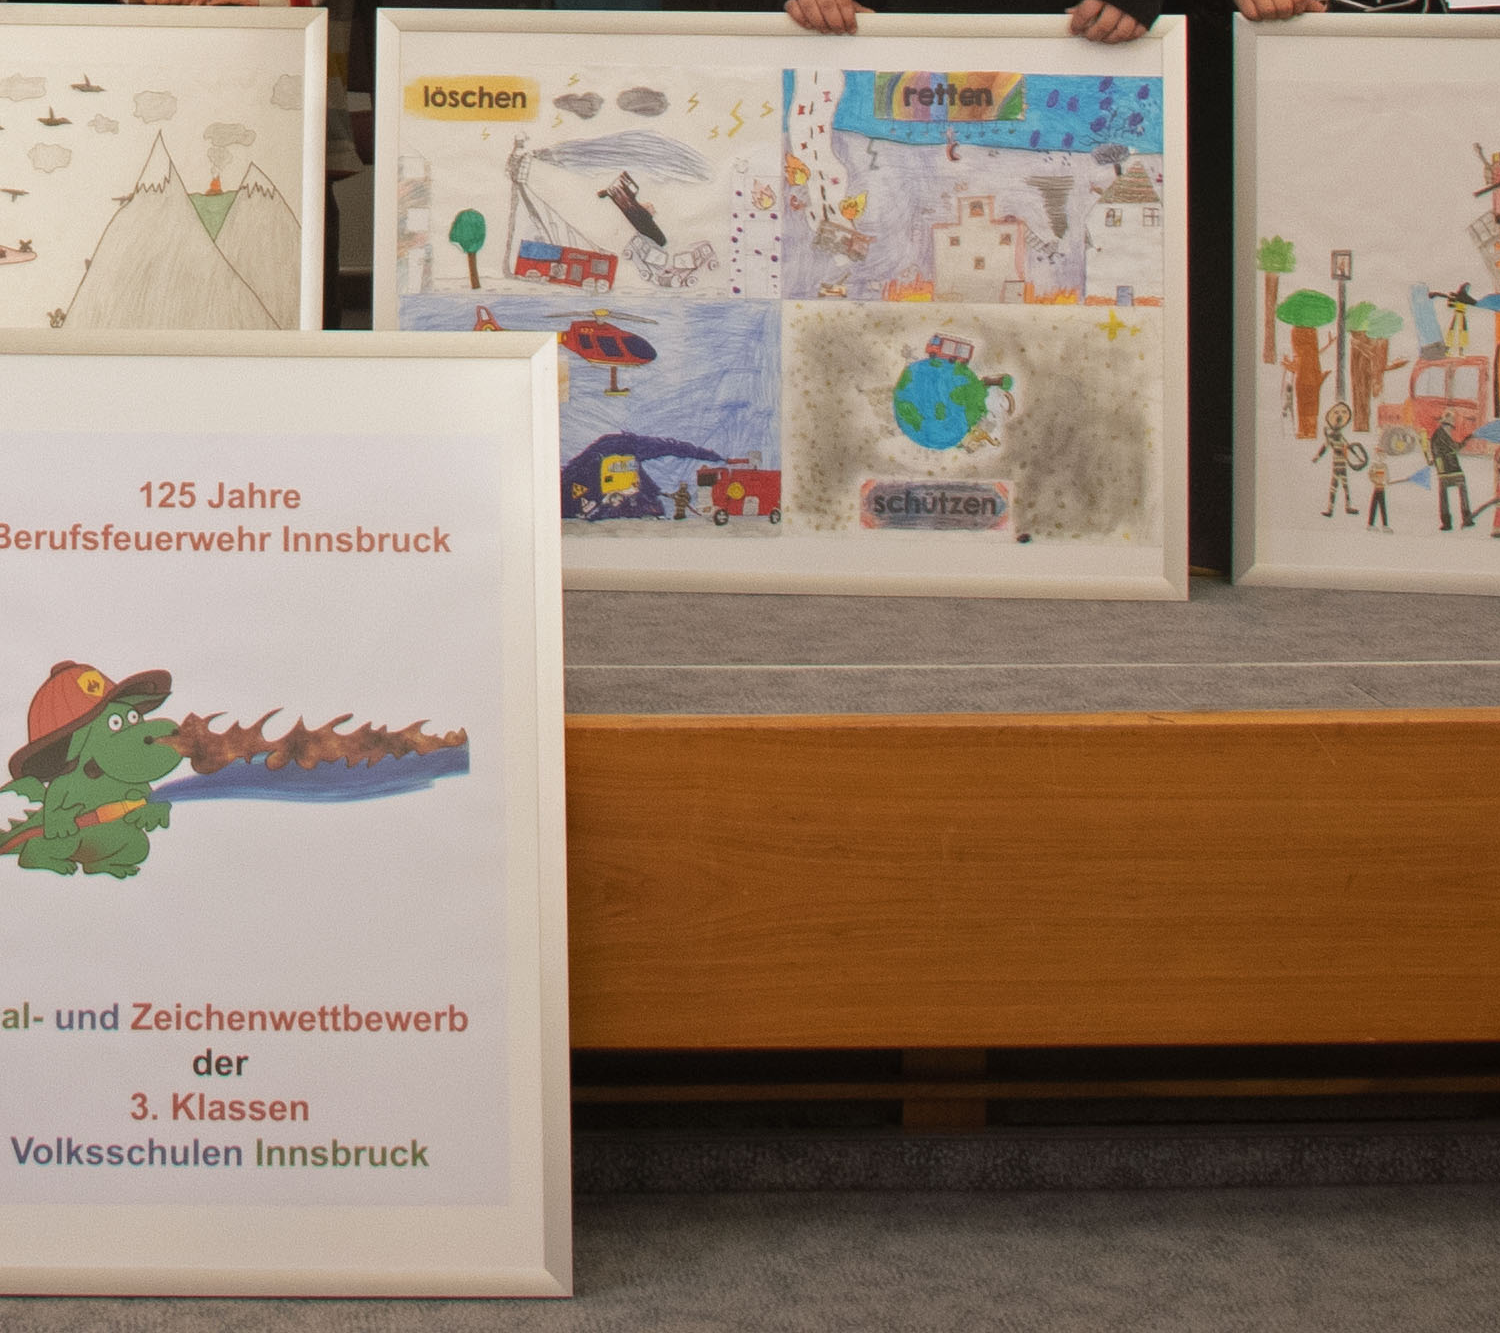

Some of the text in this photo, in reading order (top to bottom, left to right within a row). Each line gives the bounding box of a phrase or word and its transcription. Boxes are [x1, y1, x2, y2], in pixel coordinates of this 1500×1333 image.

[424, 85, 526, 108] löschen
[903, 83, 994, 107] retten
[139, 481, 301, 510] 125 Jahre
[873, 490, 997, 516] schützen
[283, 525, 452, 554] Innsbruck
[55, 1002, 119, 1031] und
[130, 1002, 469, 1033] Zeichenwettbewerb
[192, 1048, 249, 1077] der
[130, 1092, 310, 1122] 3. Klassen
[10, 1136, 429, 1168] Volksschulen Innsbruck
